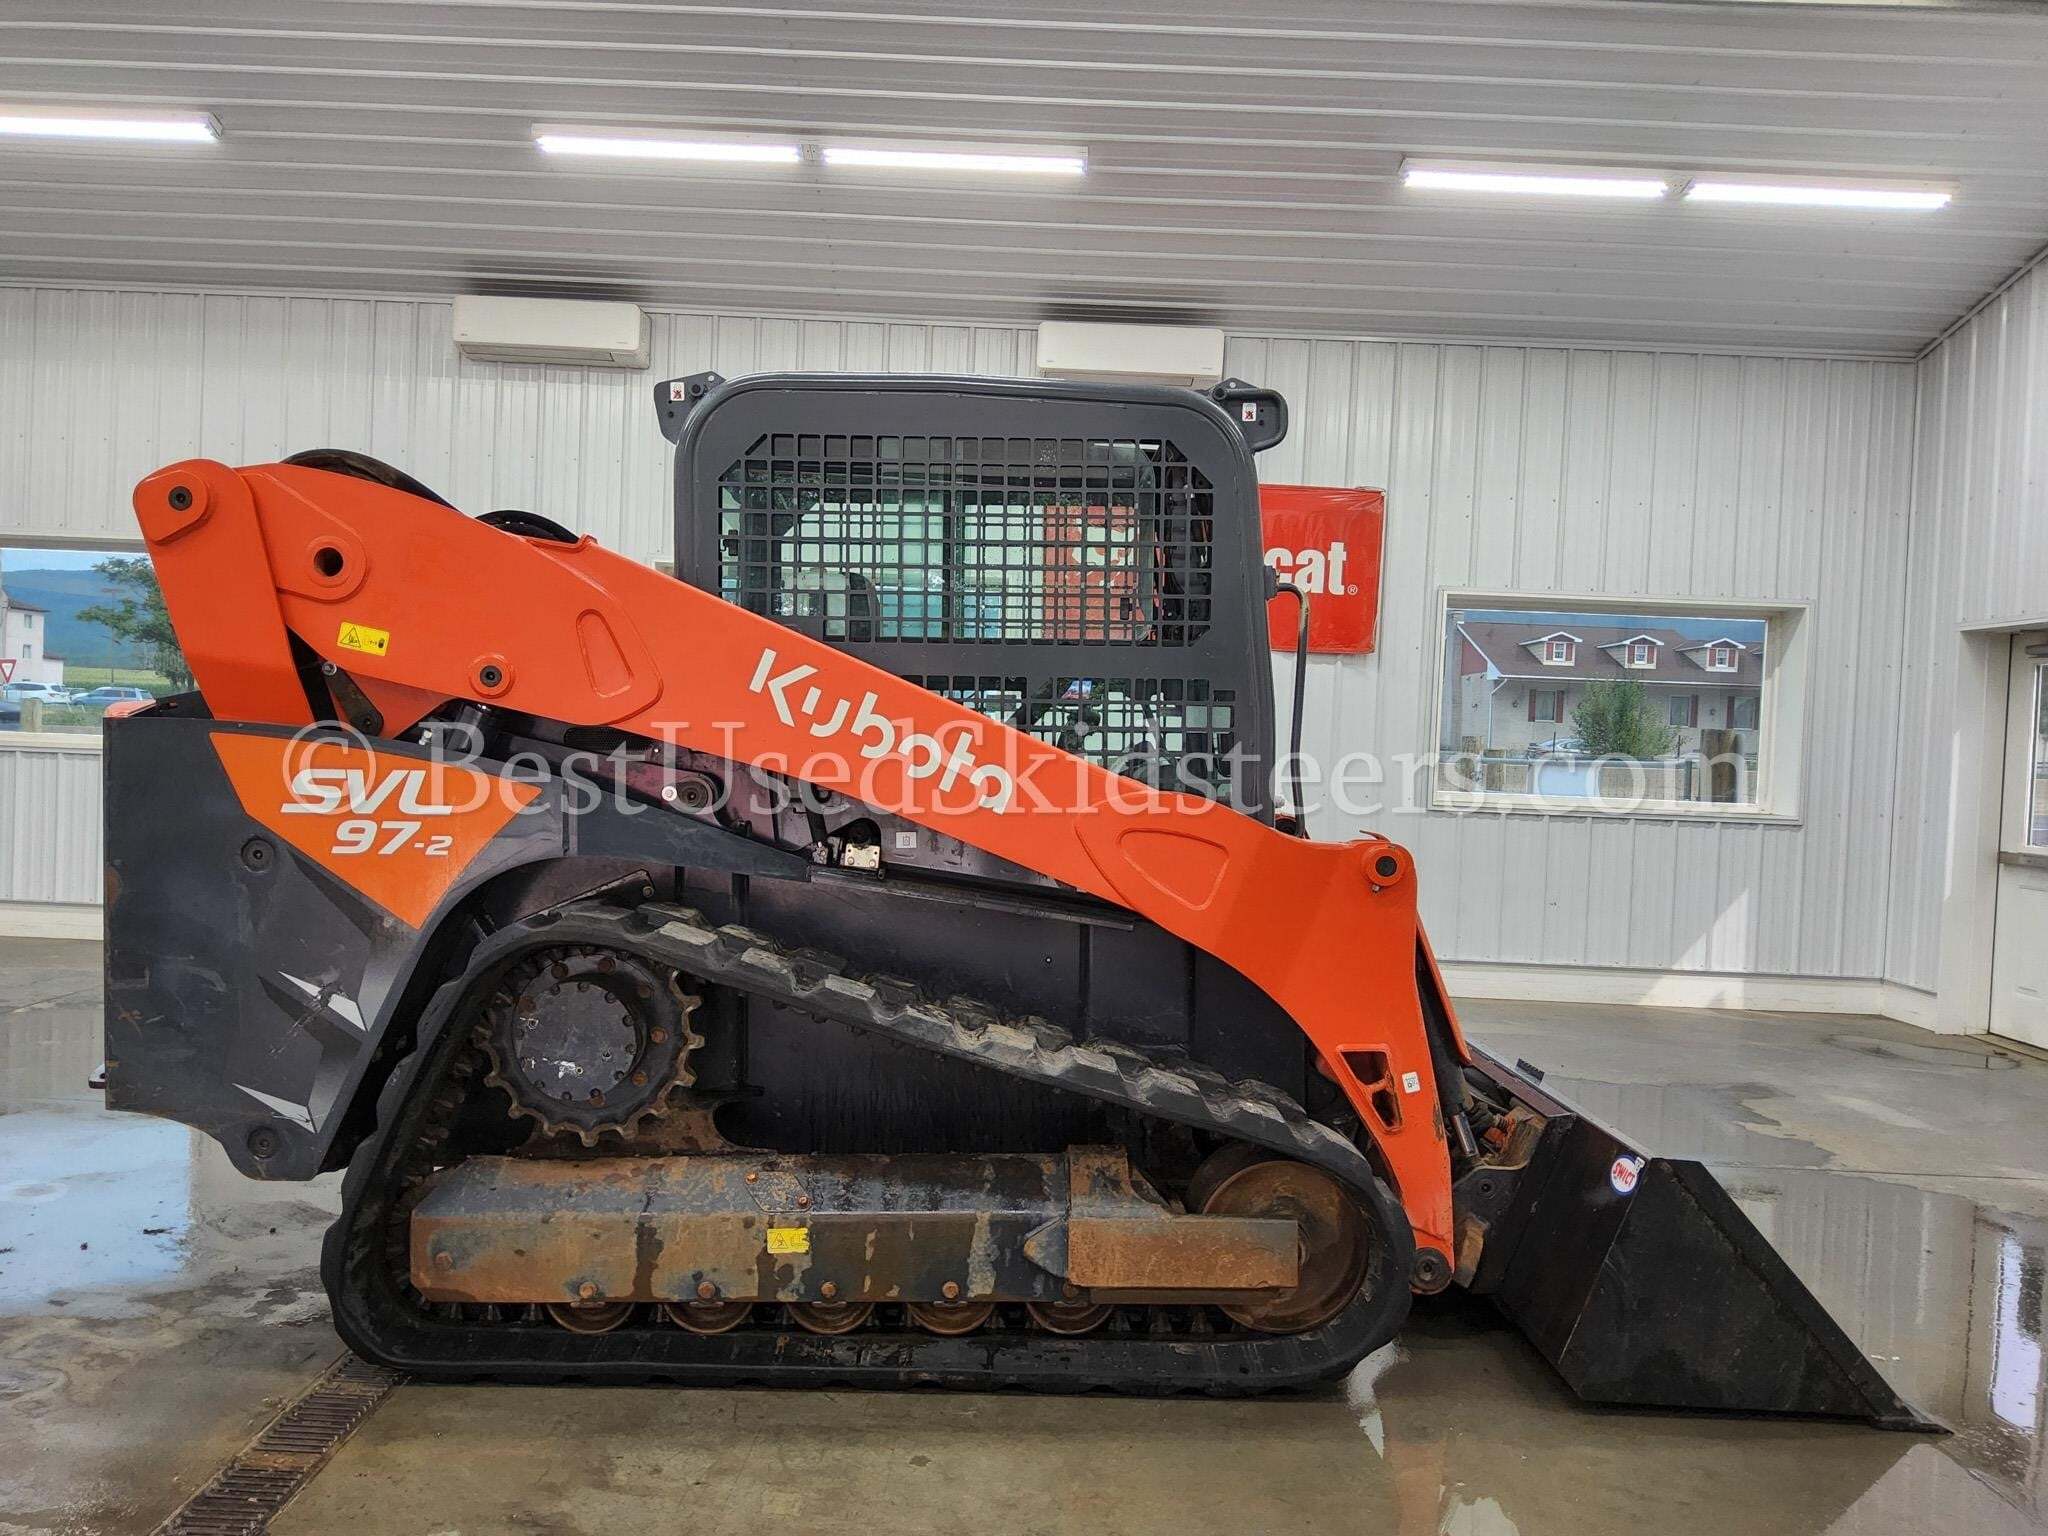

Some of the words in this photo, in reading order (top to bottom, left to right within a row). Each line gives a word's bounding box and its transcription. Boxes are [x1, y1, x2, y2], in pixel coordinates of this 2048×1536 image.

[749, 648, 1013, 816] Kubota
[280, 768, 453, 815] SVL
[331, 819, 453, 856] 97-2
